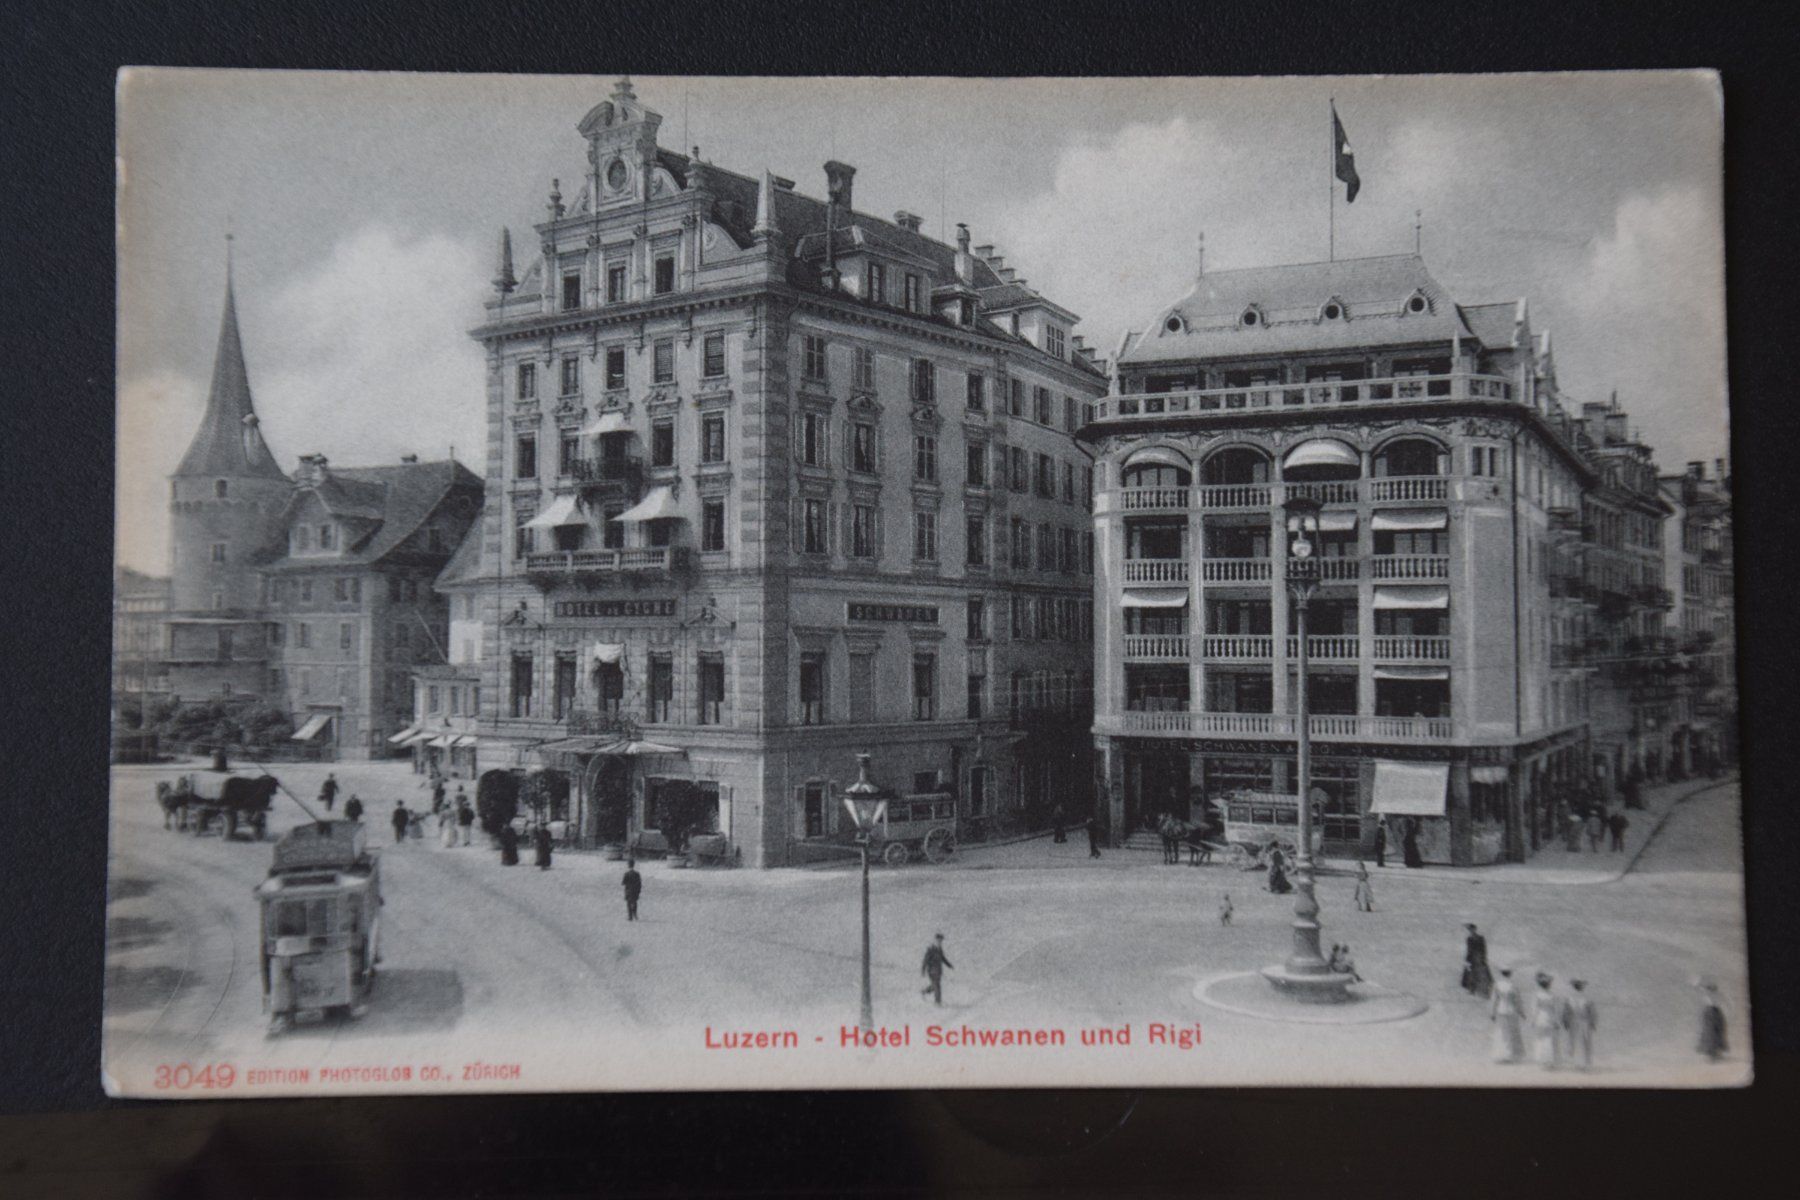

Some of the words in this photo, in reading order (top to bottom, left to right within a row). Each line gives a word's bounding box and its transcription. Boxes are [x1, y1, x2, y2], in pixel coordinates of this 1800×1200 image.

[556, 602, 601, 616] HOTEL
[624, 601, 672, 615] CYGNE
[856, 605, 932, 621] SCHWANEN
[1193, 740, 1280, 753] SCHWANEN
[705, 1026, 799, 1050] Luzern
[840, 1024, 910, 1048] Hotel
[926, 1024, 1066, 1048] Schwanen
[1081, 1024, 1131, 1047] und
[1149, 1023, 1202, 1050] Rigi
[153, 1062, 236, 1090] 3049
[247, 1069, 310, 1085] EDITION
[319, 1065, 413, 1083] PHOTOGLOB
[462, 1061, 521, 1081] ZÜRICH
